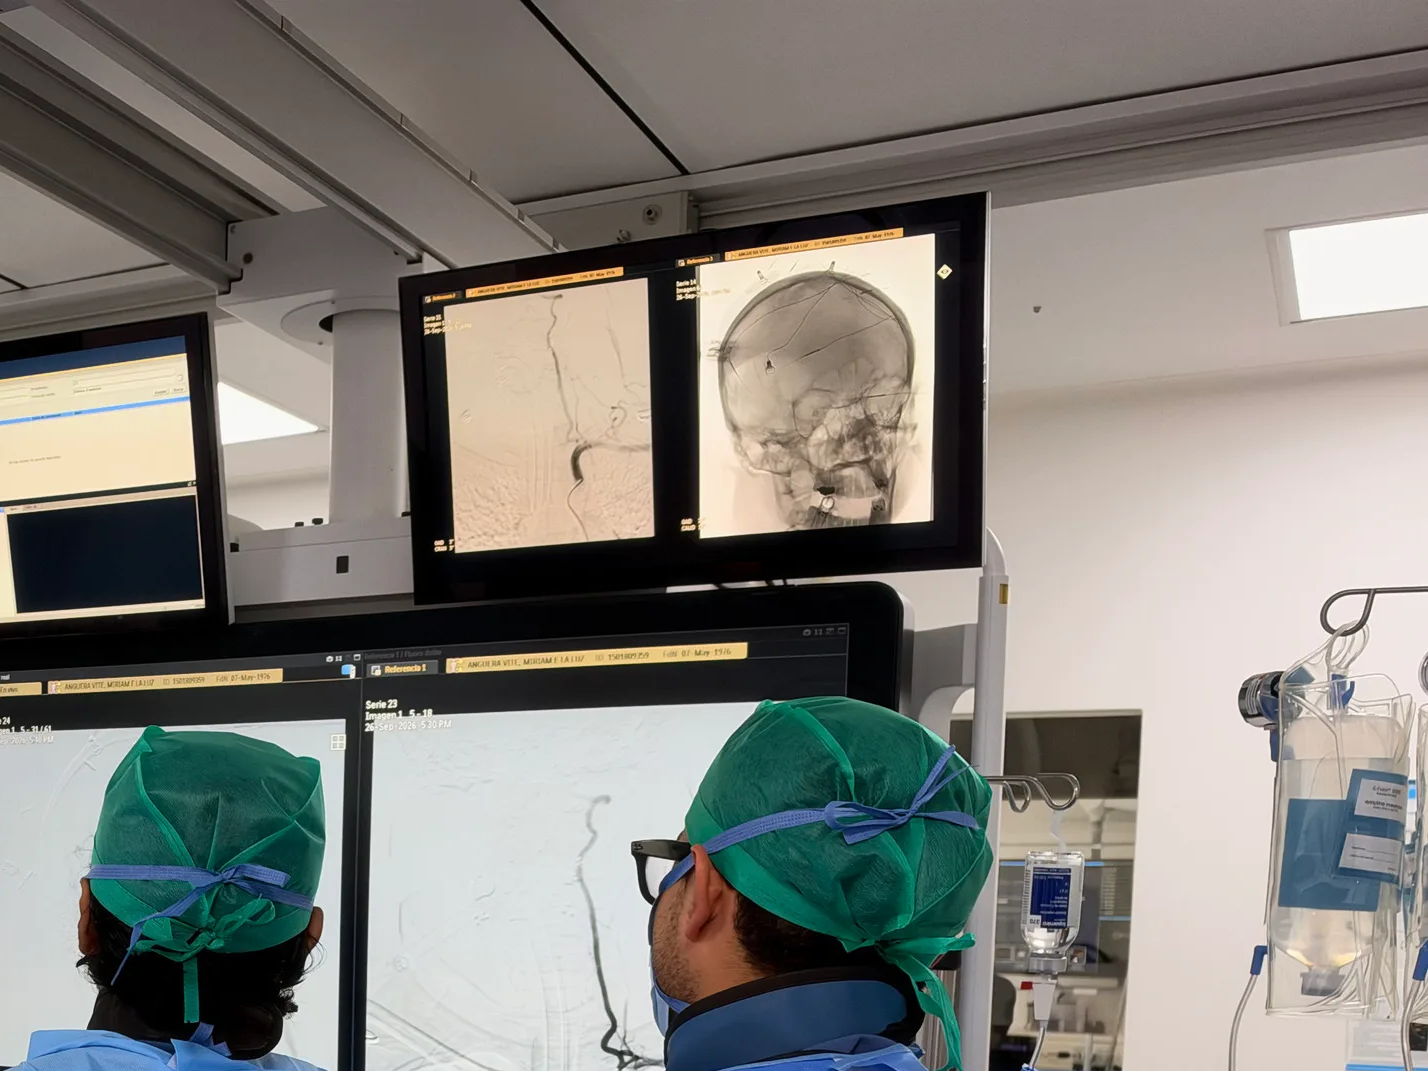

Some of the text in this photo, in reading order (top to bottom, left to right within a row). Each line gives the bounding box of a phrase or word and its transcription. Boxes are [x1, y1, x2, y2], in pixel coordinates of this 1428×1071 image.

[365, 698, 398, 709] Serie 23
[2, 716, 11, 725] 24
[365, 711, 397, 721] Imagen
